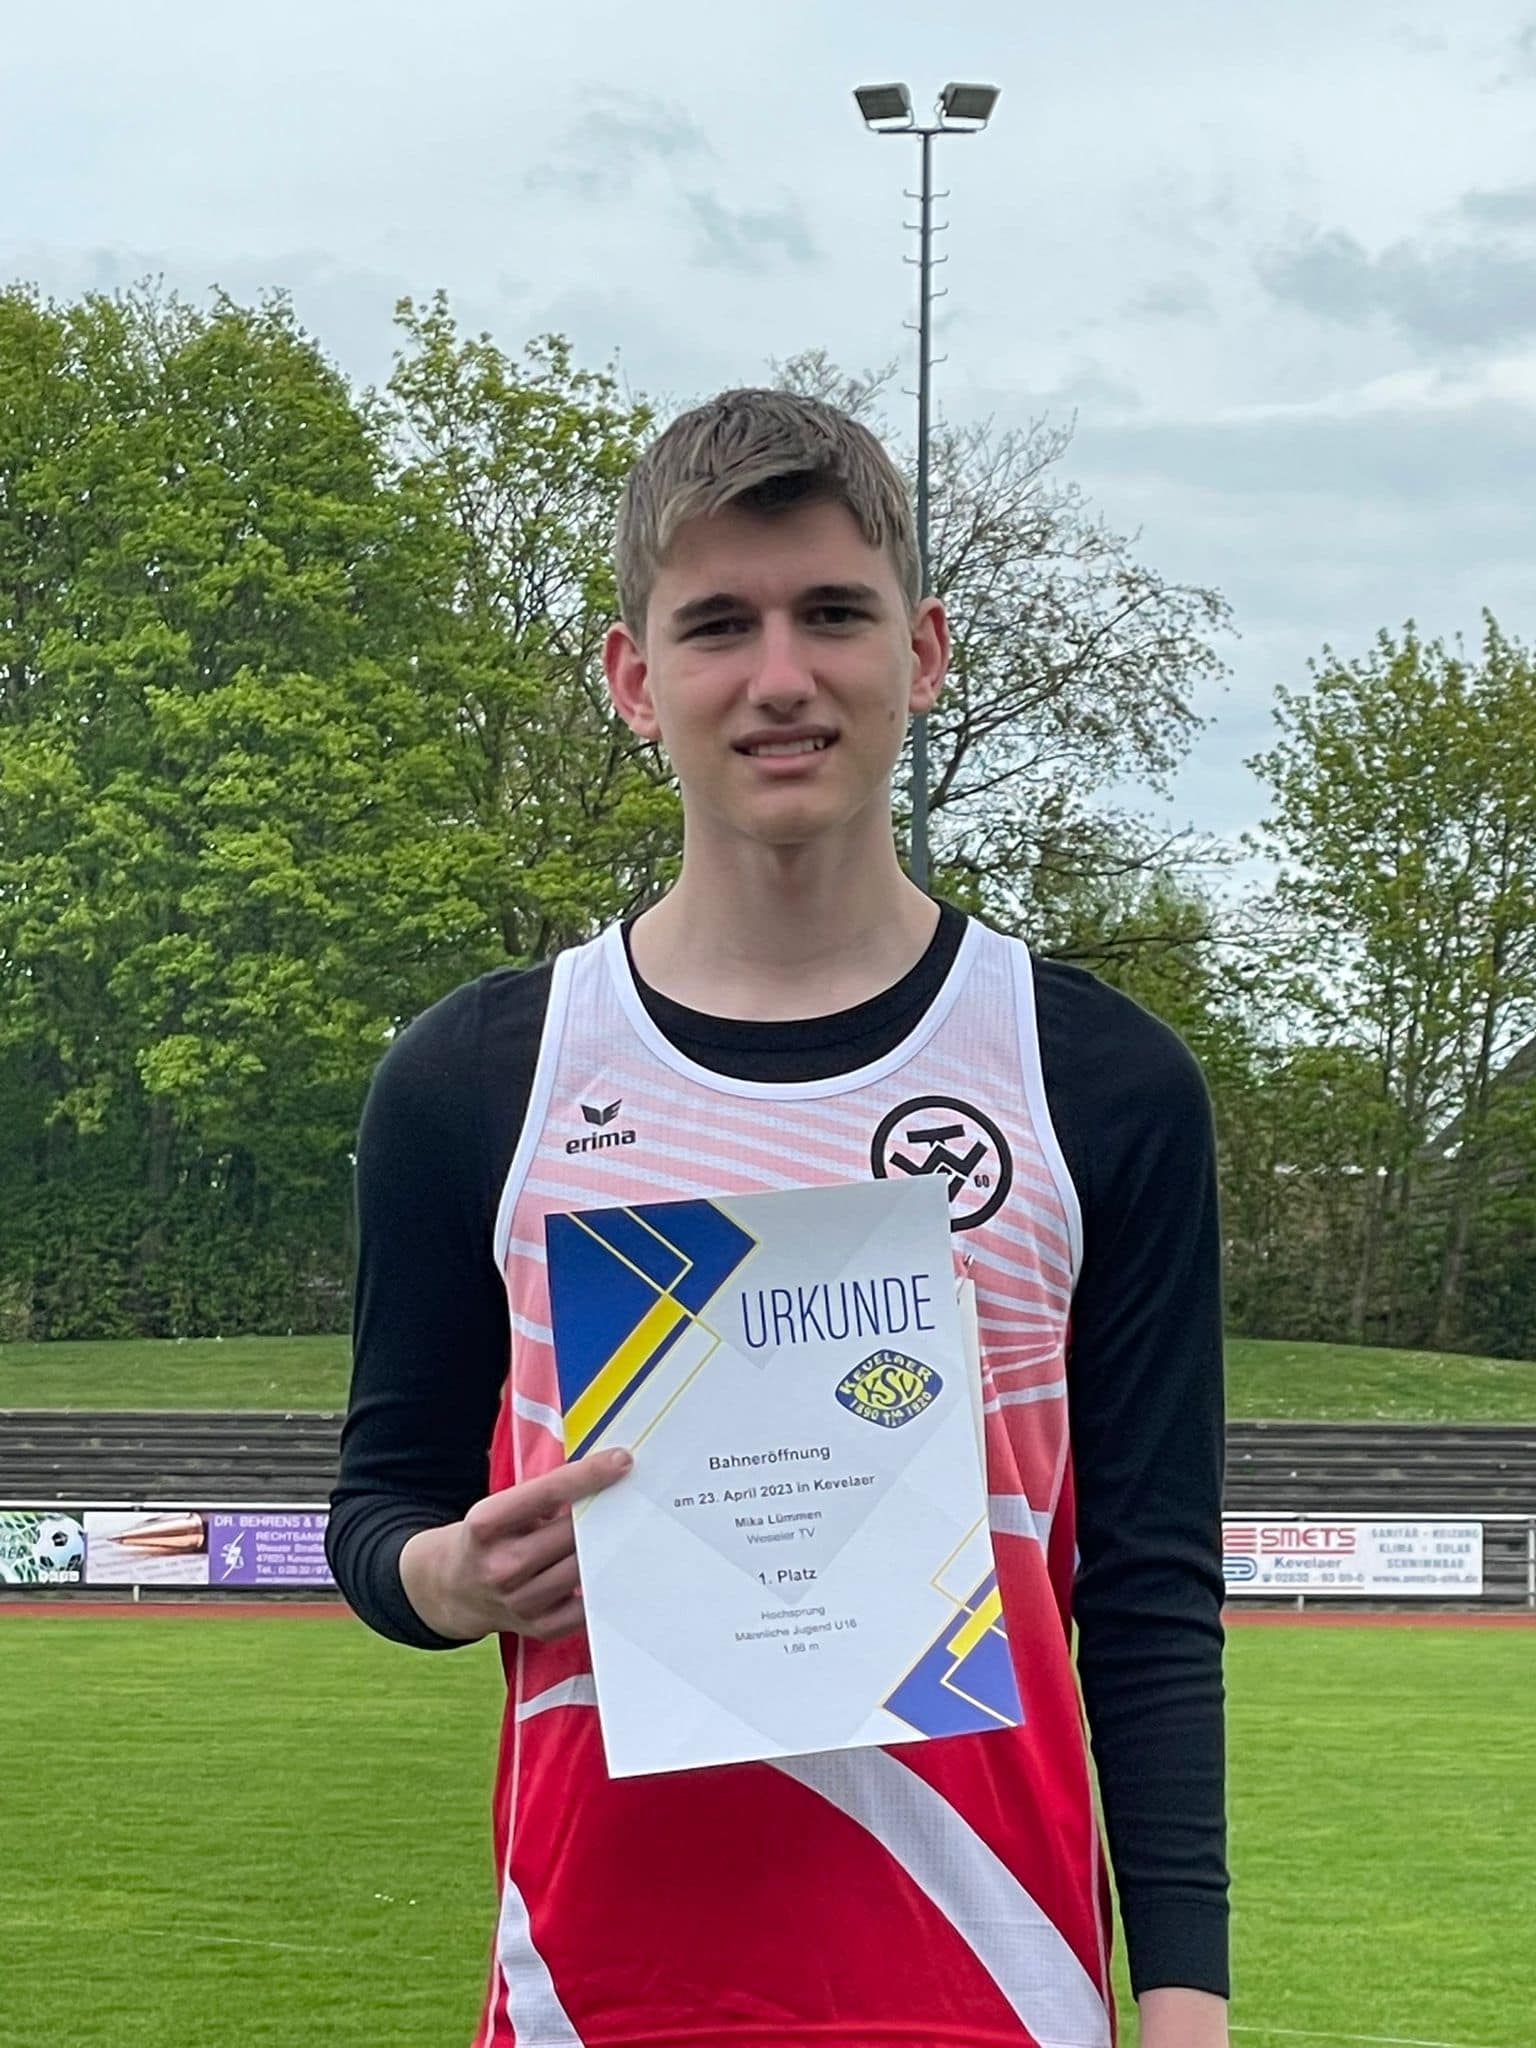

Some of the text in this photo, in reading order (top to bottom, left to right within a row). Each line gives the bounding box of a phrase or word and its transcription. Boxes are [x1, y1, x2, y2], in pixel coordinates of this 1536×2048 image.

[565, 1129, 636, 1154] erima
[741, 1274, 936, 1349] URKUNDE
[862, 1367, 918, 1408] KSV
[709, 1446, 831, 1470] Bahneröffnung
[673, 1474, 876, 1508] am 23. April 2023 in Kevelaer
[240, 1515, 300, 1528] BEHRENS
[303, 1516, 312, 1528] &
[734, 1517, 764, 1528] Mika
[799, 1528, 816, 1538] TV
[1260, 1528, 1356, 1547] SMETS
[1380, 1543, 1414, 1553] KLIMA
[1274, 1556, 1343, 1569] Kevelaer
[758, 1568, 817, 1585] 1. Platz
[760, 1606, 826, 1620] Hochsprung
[793, 1622, 832, 1636] Jugend
